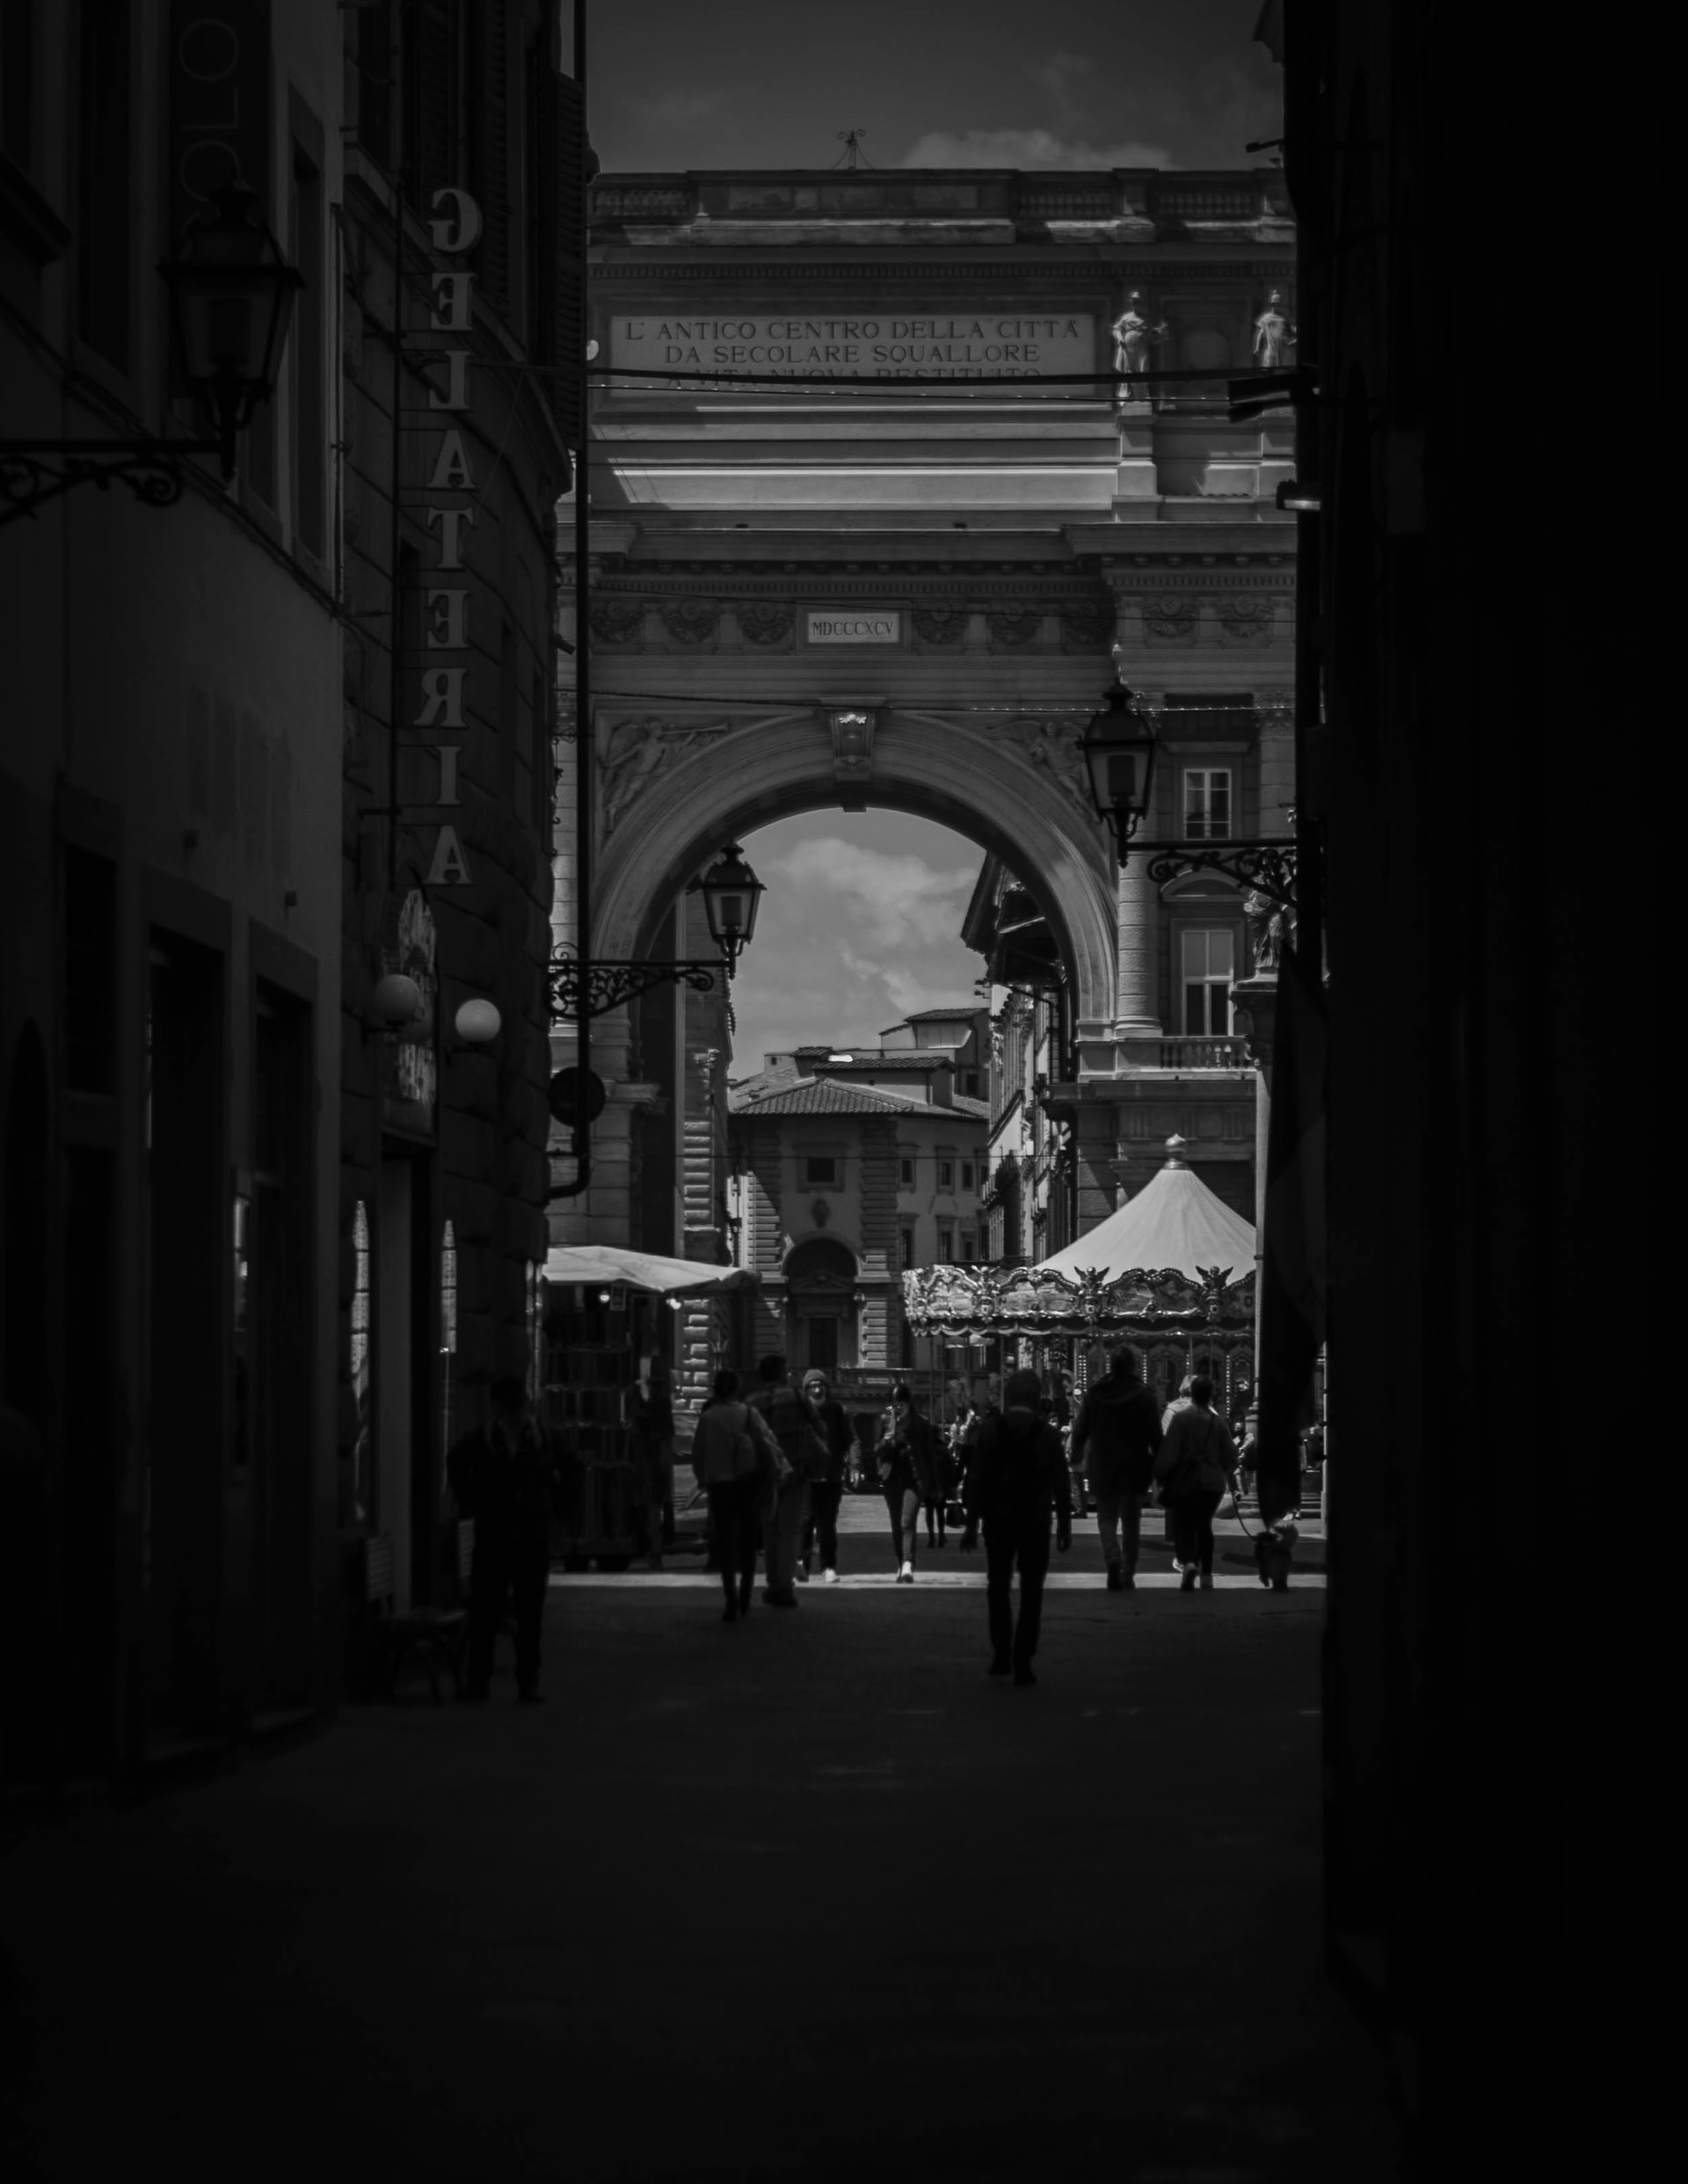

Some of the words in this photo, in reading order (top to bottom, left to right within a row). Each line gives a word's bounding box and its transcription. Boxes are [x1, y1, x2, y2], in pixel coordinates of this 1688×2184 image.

[655, 321, 757, 340] ANTICO
[768, 321, 880, 340] CENTRO
[891, 320, 986, 339] DELLA
[666, 346, 702, 364] DA
[713, 345, 861, 364] SECOLARE
[872, 344, 1041, 365] SQUALLORE
[812, 621, 894, 636] MDCCCXCV
